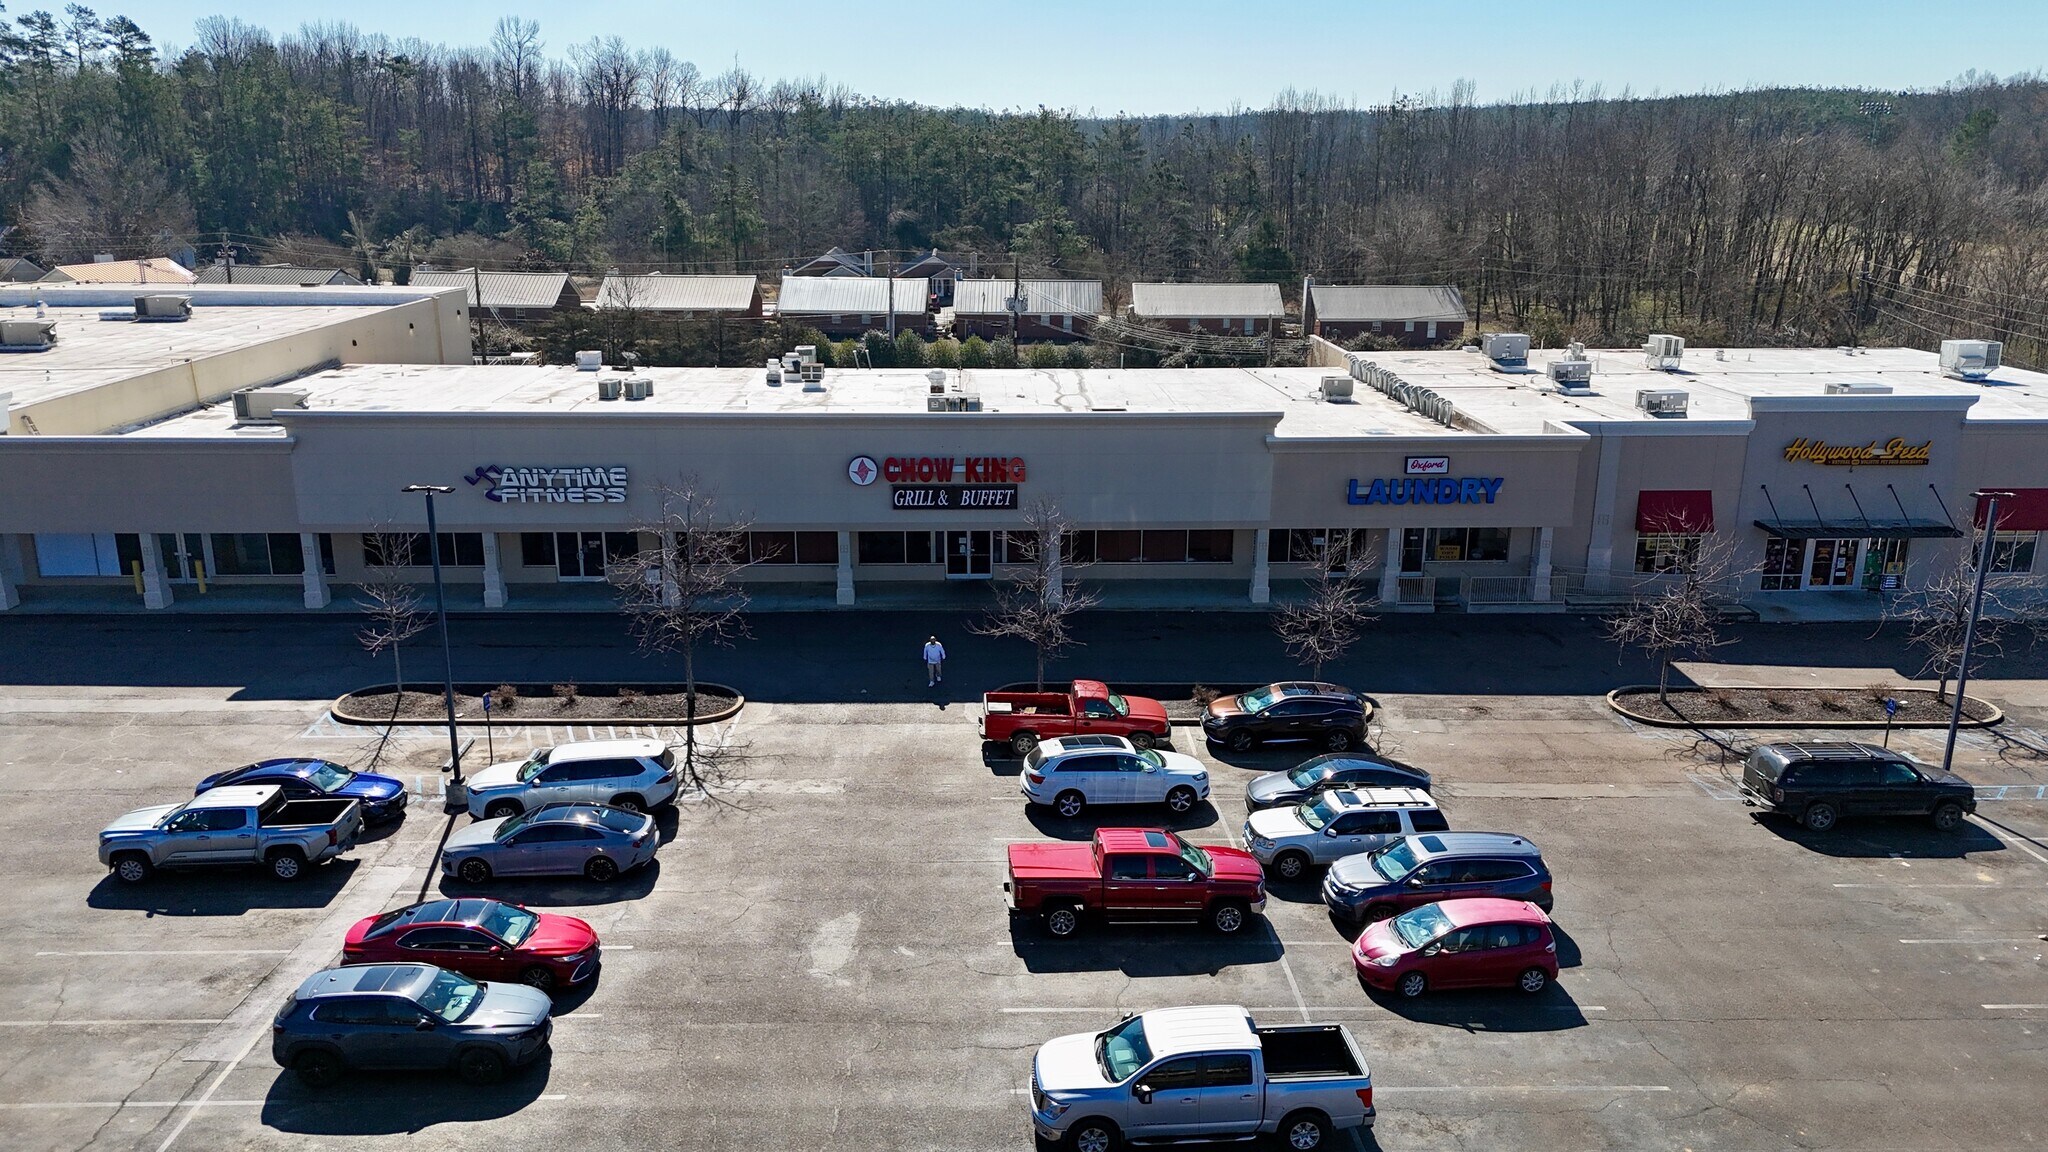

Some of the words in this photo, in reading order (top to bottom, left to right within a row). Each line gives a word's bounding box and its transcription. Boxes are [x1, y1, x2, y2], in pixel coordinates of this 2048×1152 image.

[1784, 438, 1877, 464] Hollywood
[1880, 437, 1933, 459] Feed
[884, 457, 955, 483] CHOW
[965, 457, 1026, 483] KING
[1410, 459, 1445, 472] Oxford
[500, 467, 627, 486] ANYTIME
[501, 487, 626, 503] FITNESS
[894, 489, 936, 506] GRILL
[937, 490, 949, 506] &
[960, 489, 1015, 506] BUFFET
[1347, 478, 1504, 505] LAUNDRY
